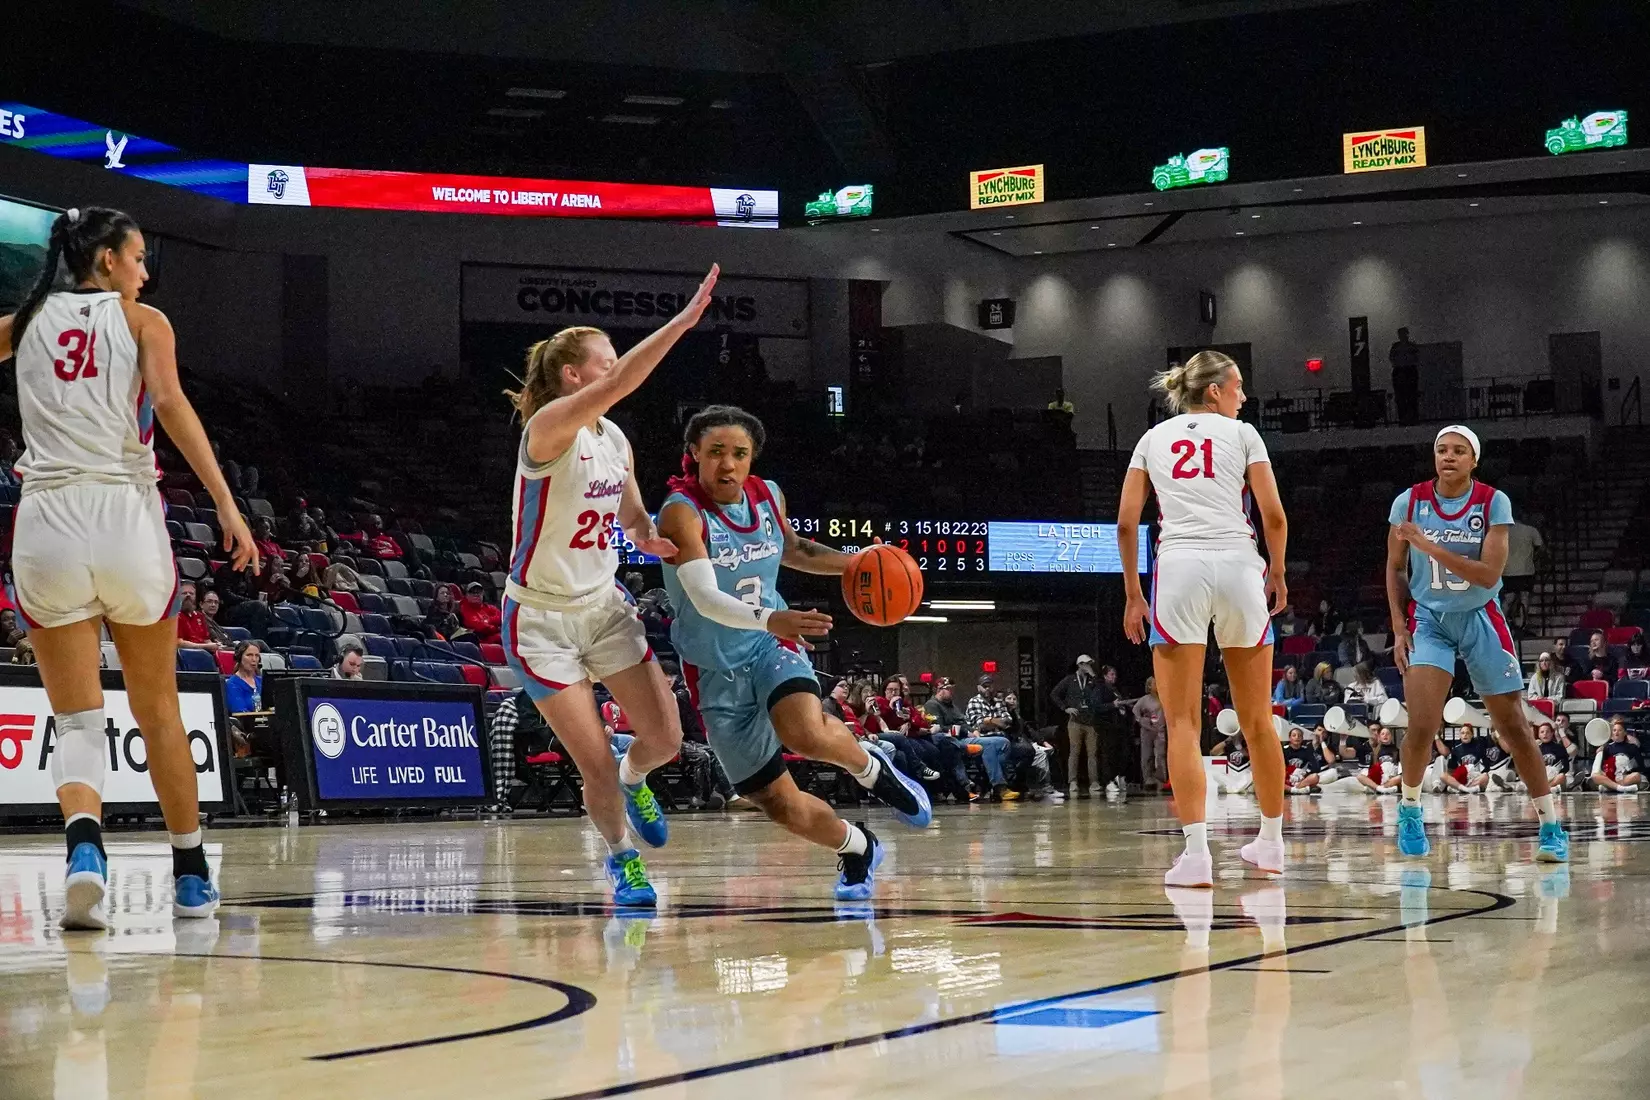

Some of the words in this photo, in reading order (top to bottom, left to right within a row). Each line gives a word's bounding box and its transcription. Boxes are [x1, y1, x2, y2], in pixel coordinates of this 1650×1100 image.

[1352, 138, 1416, 159] LYNCHBURG
[1353, 157, 1392, 169] READY
[1394, 154, 1416, 165] MIX
[978, 176, 1036, 195] LYNCHBURG
[432, 186, 491, 203] WELCOME
[493, 190, 509, 204] TO
[511, 190, 558, 206] LIBERTY
[561, 193, 602, 209] ARENA
[978, 193, 1014, 205] READY
[1015, 190, 1036, 202] MIX
[516, 286, 756, 322] CONCESSINS
[53, 328, 99, 382] 31
[1170, 438, 1216, 480] 21
[803, 518, 820, 532] 31
[828, 518, 874, 538] 8:14
[884, 522, 892, 532] #
[899, 520, 909, 534] 3
[915, 521, 932, 535] 15
[934, 521, 951, 535] 18
[952, 521, 970, 535] 22
[970, 522, 988, 536] 23
[1037, 524, 1058, 537] LA
[1061, 524, 1101, 538] TECH
[841, 545, 860, 554] 3RD
[900, 539, 909, 552] 2
[921, 540, 928, 553] 1
[937, 540, 947, 553] 0
[956, 540, 966, 553] 0
[975, 541, 985, 554] 2
[1056, 541, 1083, 562] 27
[919, 557, 928, 570] 2
[938, 557, 947, 570] 2
[957, 557, 966, 571] 5
[975, 558, 985, 571] 3
[1006, 551, 1034, 562] POSS
[1019, 652, 1034, 691] MEN
[351, 715, 419, 747] Carter
[422, 715, 479, 748] Bank
[351, 766, 379, 784] LIFE
[388, 766, 425, 784] LIVED
[434, 766, 466, 783] FULL
